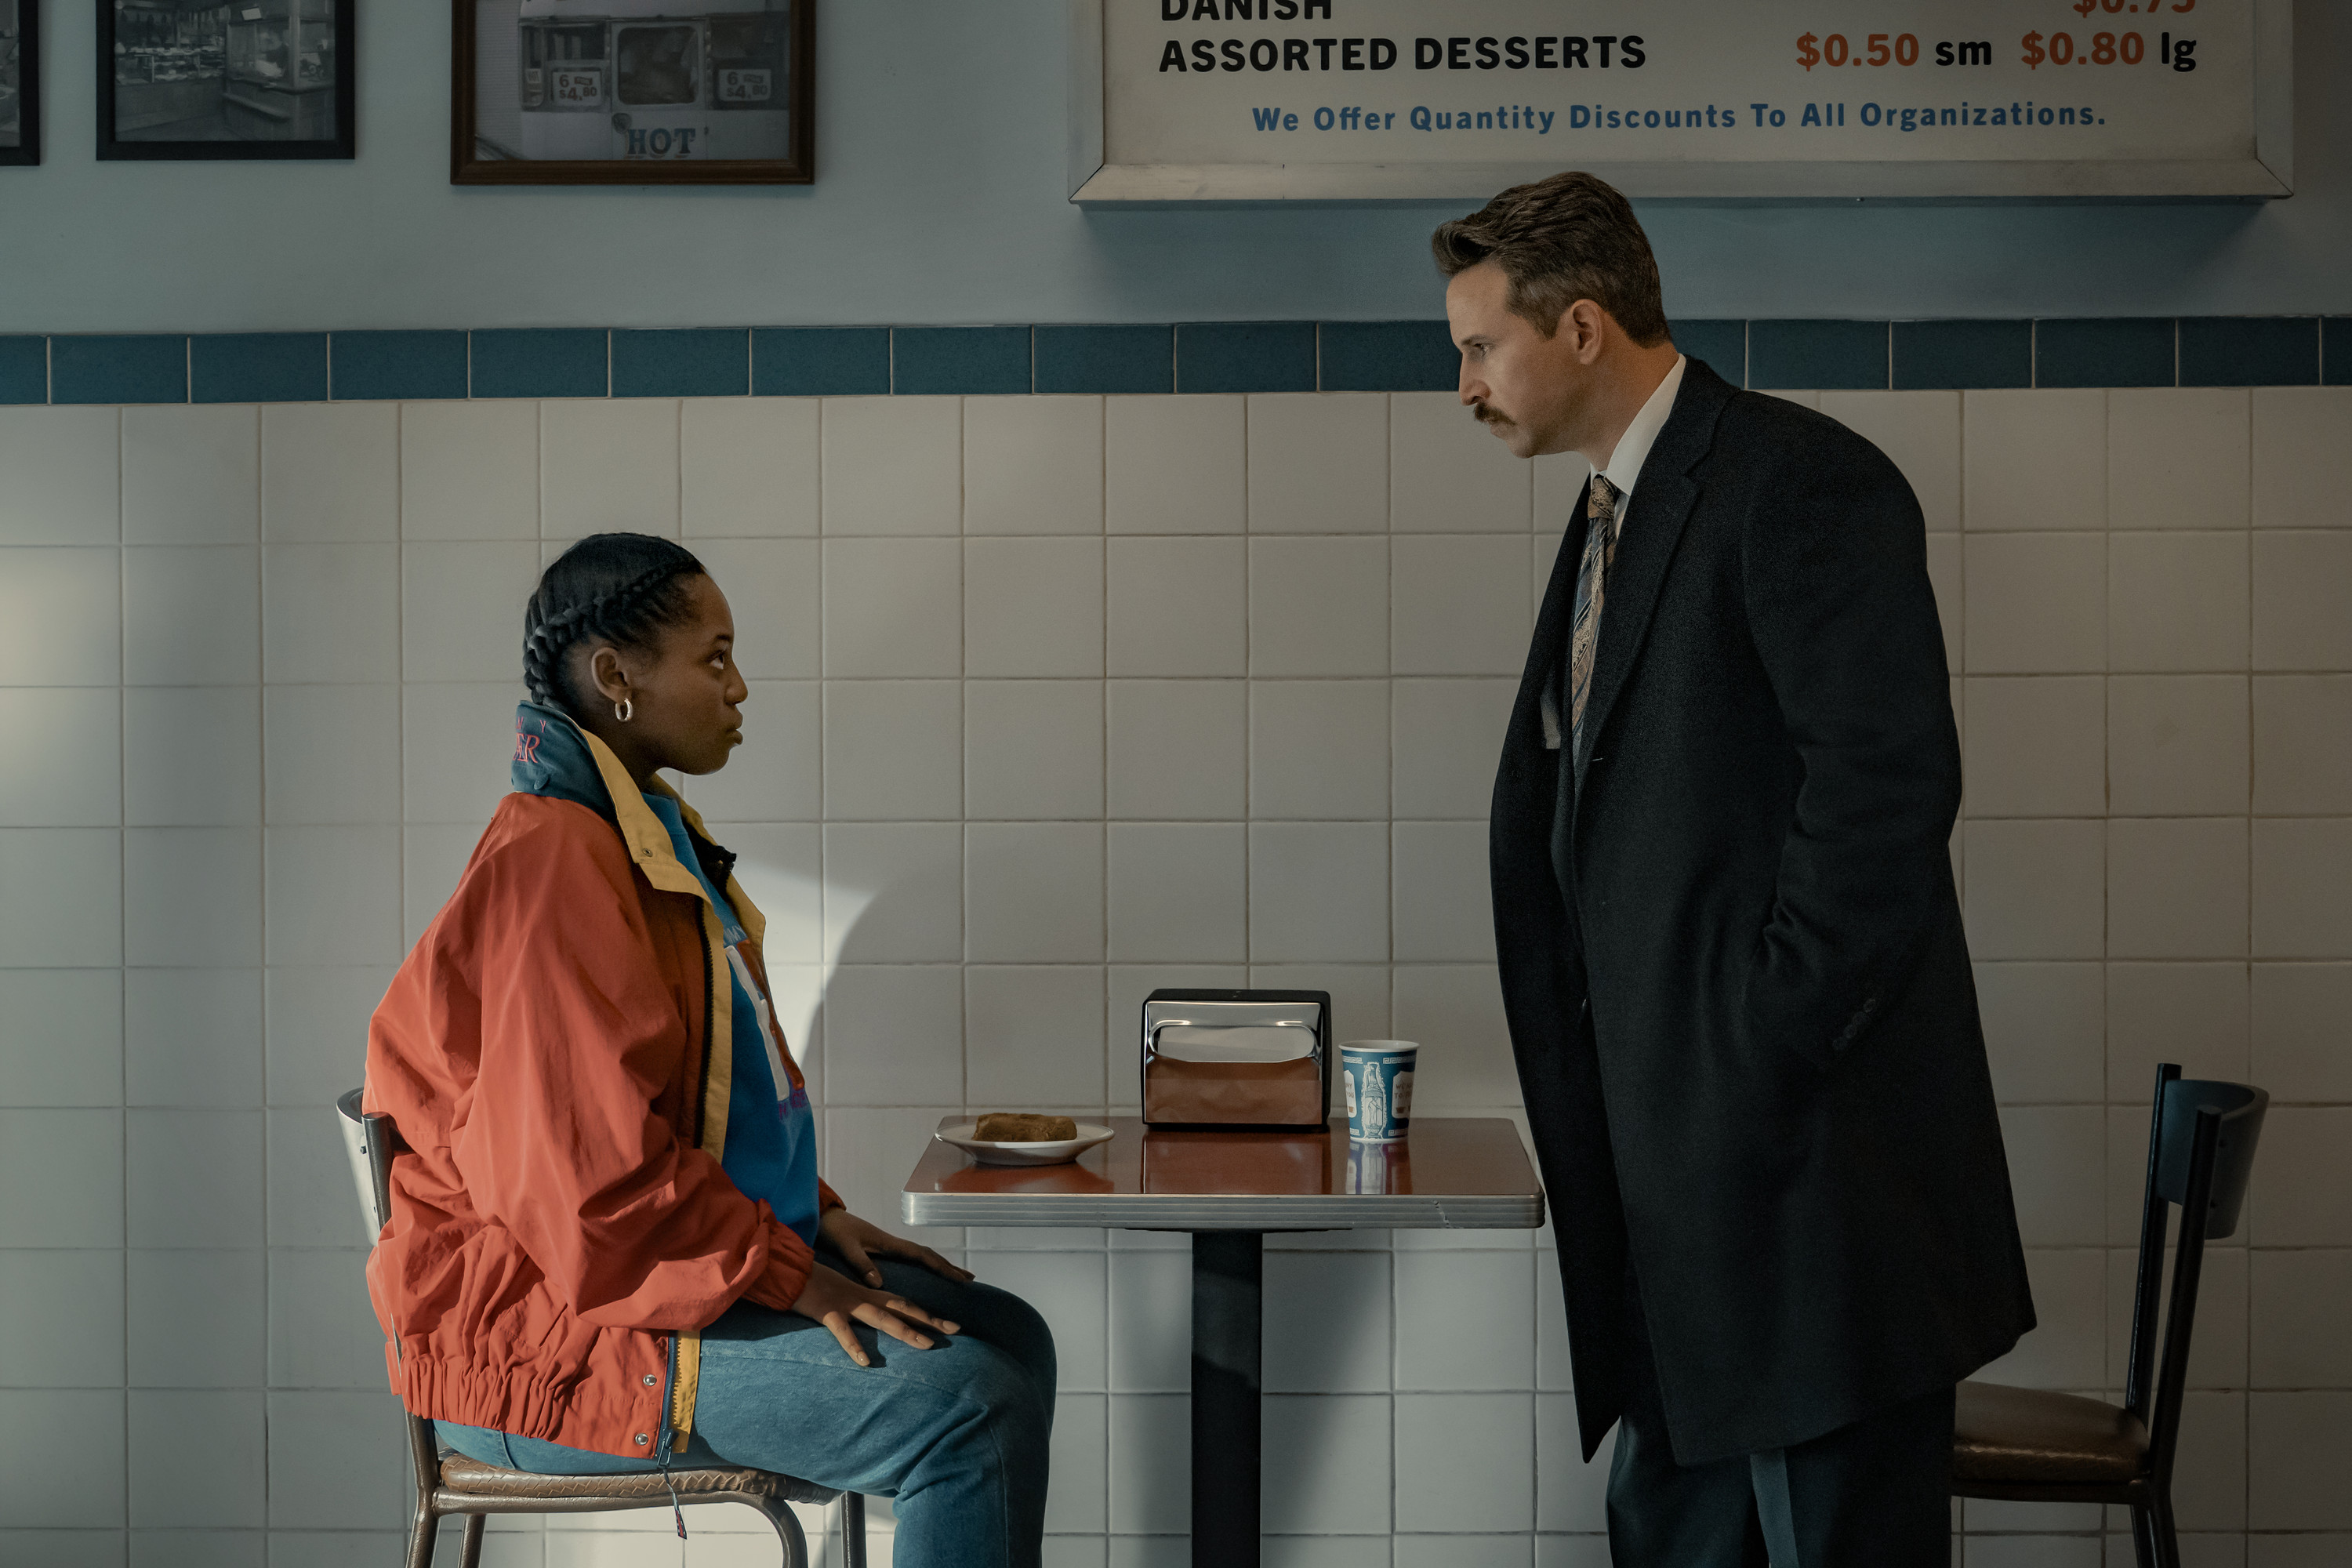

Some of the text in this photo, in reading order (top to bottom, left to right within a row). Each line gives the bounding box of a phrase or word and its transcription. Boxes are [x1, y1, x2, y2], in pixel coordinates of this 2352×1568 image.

[1162, 0, 1331, 21] DANISH
[1159, 30, 2198, 72] ASSORTED DESSERTS $0.50 sm $0.80 lg
[559, 74, 569, 88] 6
[728, 71, 738, 85] 6
[1251, 101, 2106, 135] We Offer Quantity Discounts To All Organizations.
[626, 128, 696, 158] HOT
